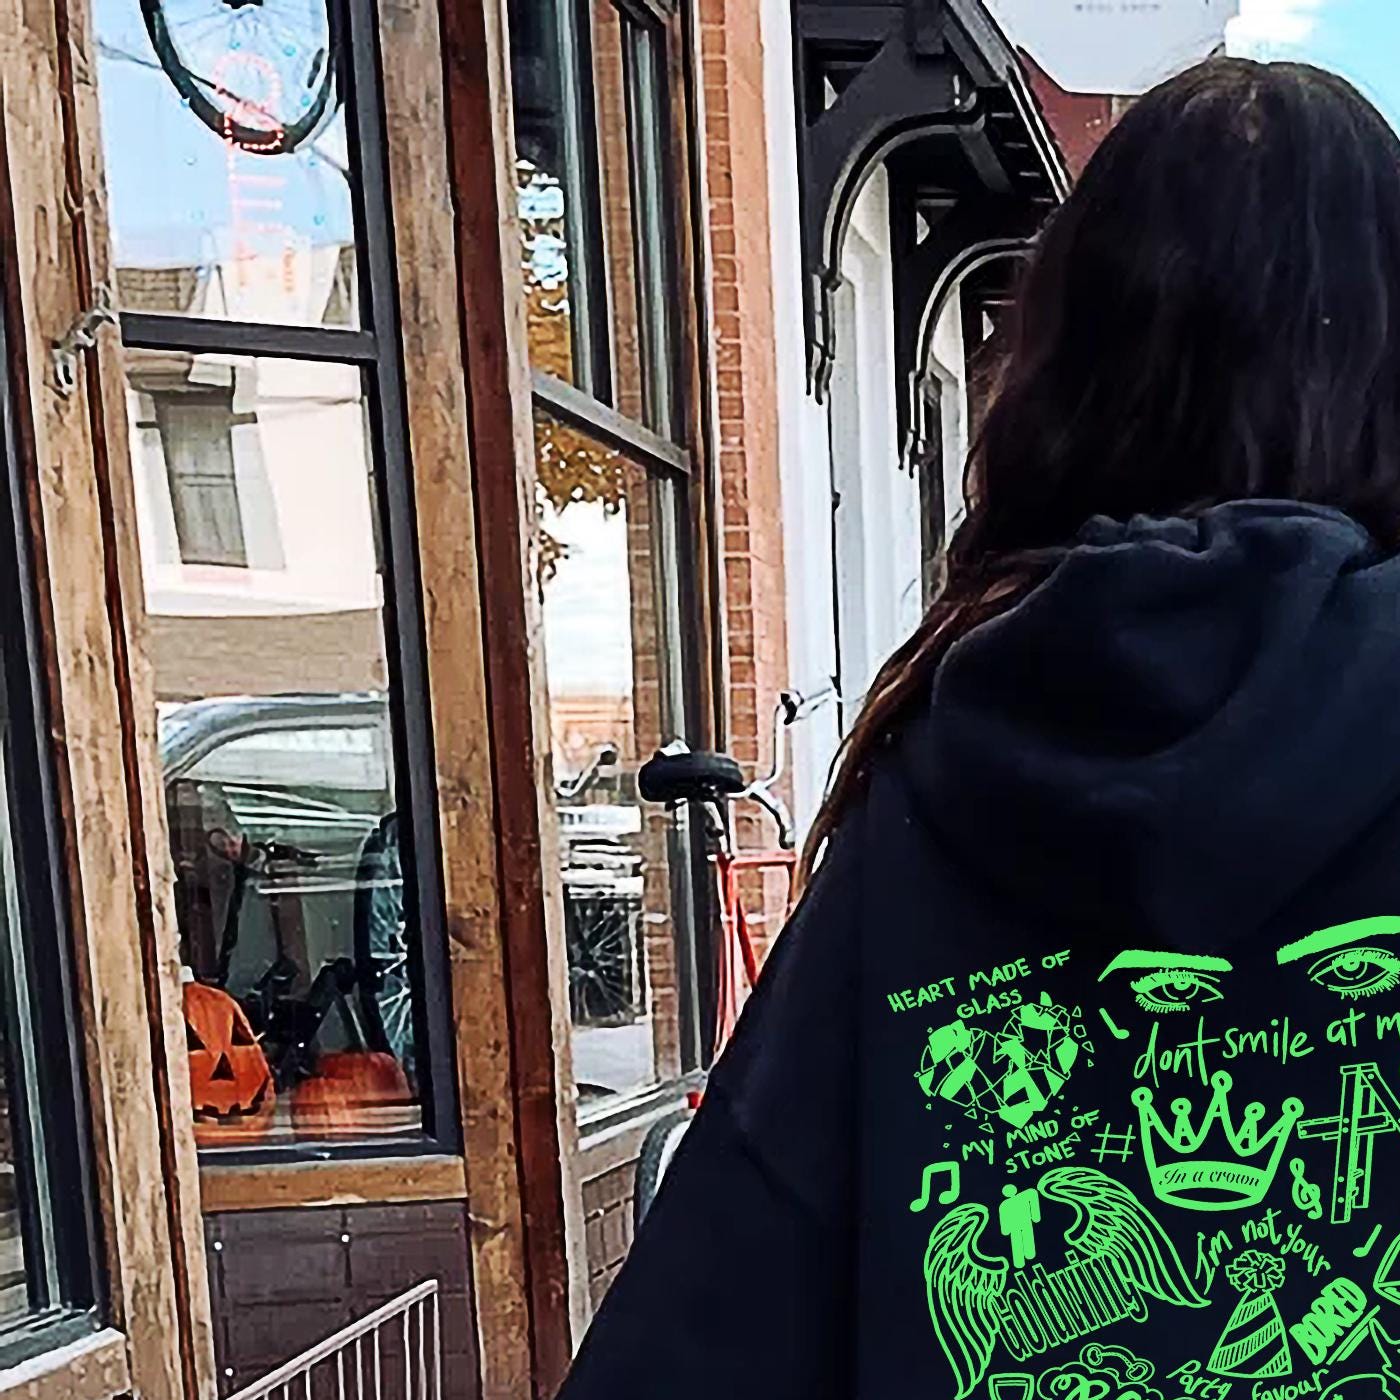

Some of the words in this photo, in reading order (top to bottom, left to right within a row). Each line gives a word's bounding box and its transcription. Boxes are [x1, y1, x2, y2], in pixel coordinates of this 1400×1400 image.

[888, 977, 955, 1012] HEART
[968, 959, 1031, 991] MADE
[1041, 950, 1071, 970] OF
[956, 989, 1023, 1019] GLASS
[1133, 1016, 1220, 1088] dont
[1221, 1017, 1315, 1064] smile
[1326, 1008, 1365, 1046] at
[1006, 1119, 1058, 1148] MIND
[1071, 1109, 1099, 1130] OF
[1005, 1138, 1076, 1173] STONE
[1159, 1169, 1187, 1185] In
[1193, 1171, 1204, 1183] a
[1209, 1171, 1260, 1187] crown
[1242, 1208, 1283, 1245] not
[1281, 1224, 1331, 1277] your
[1289, 1277, 1368, 1365] BORED
